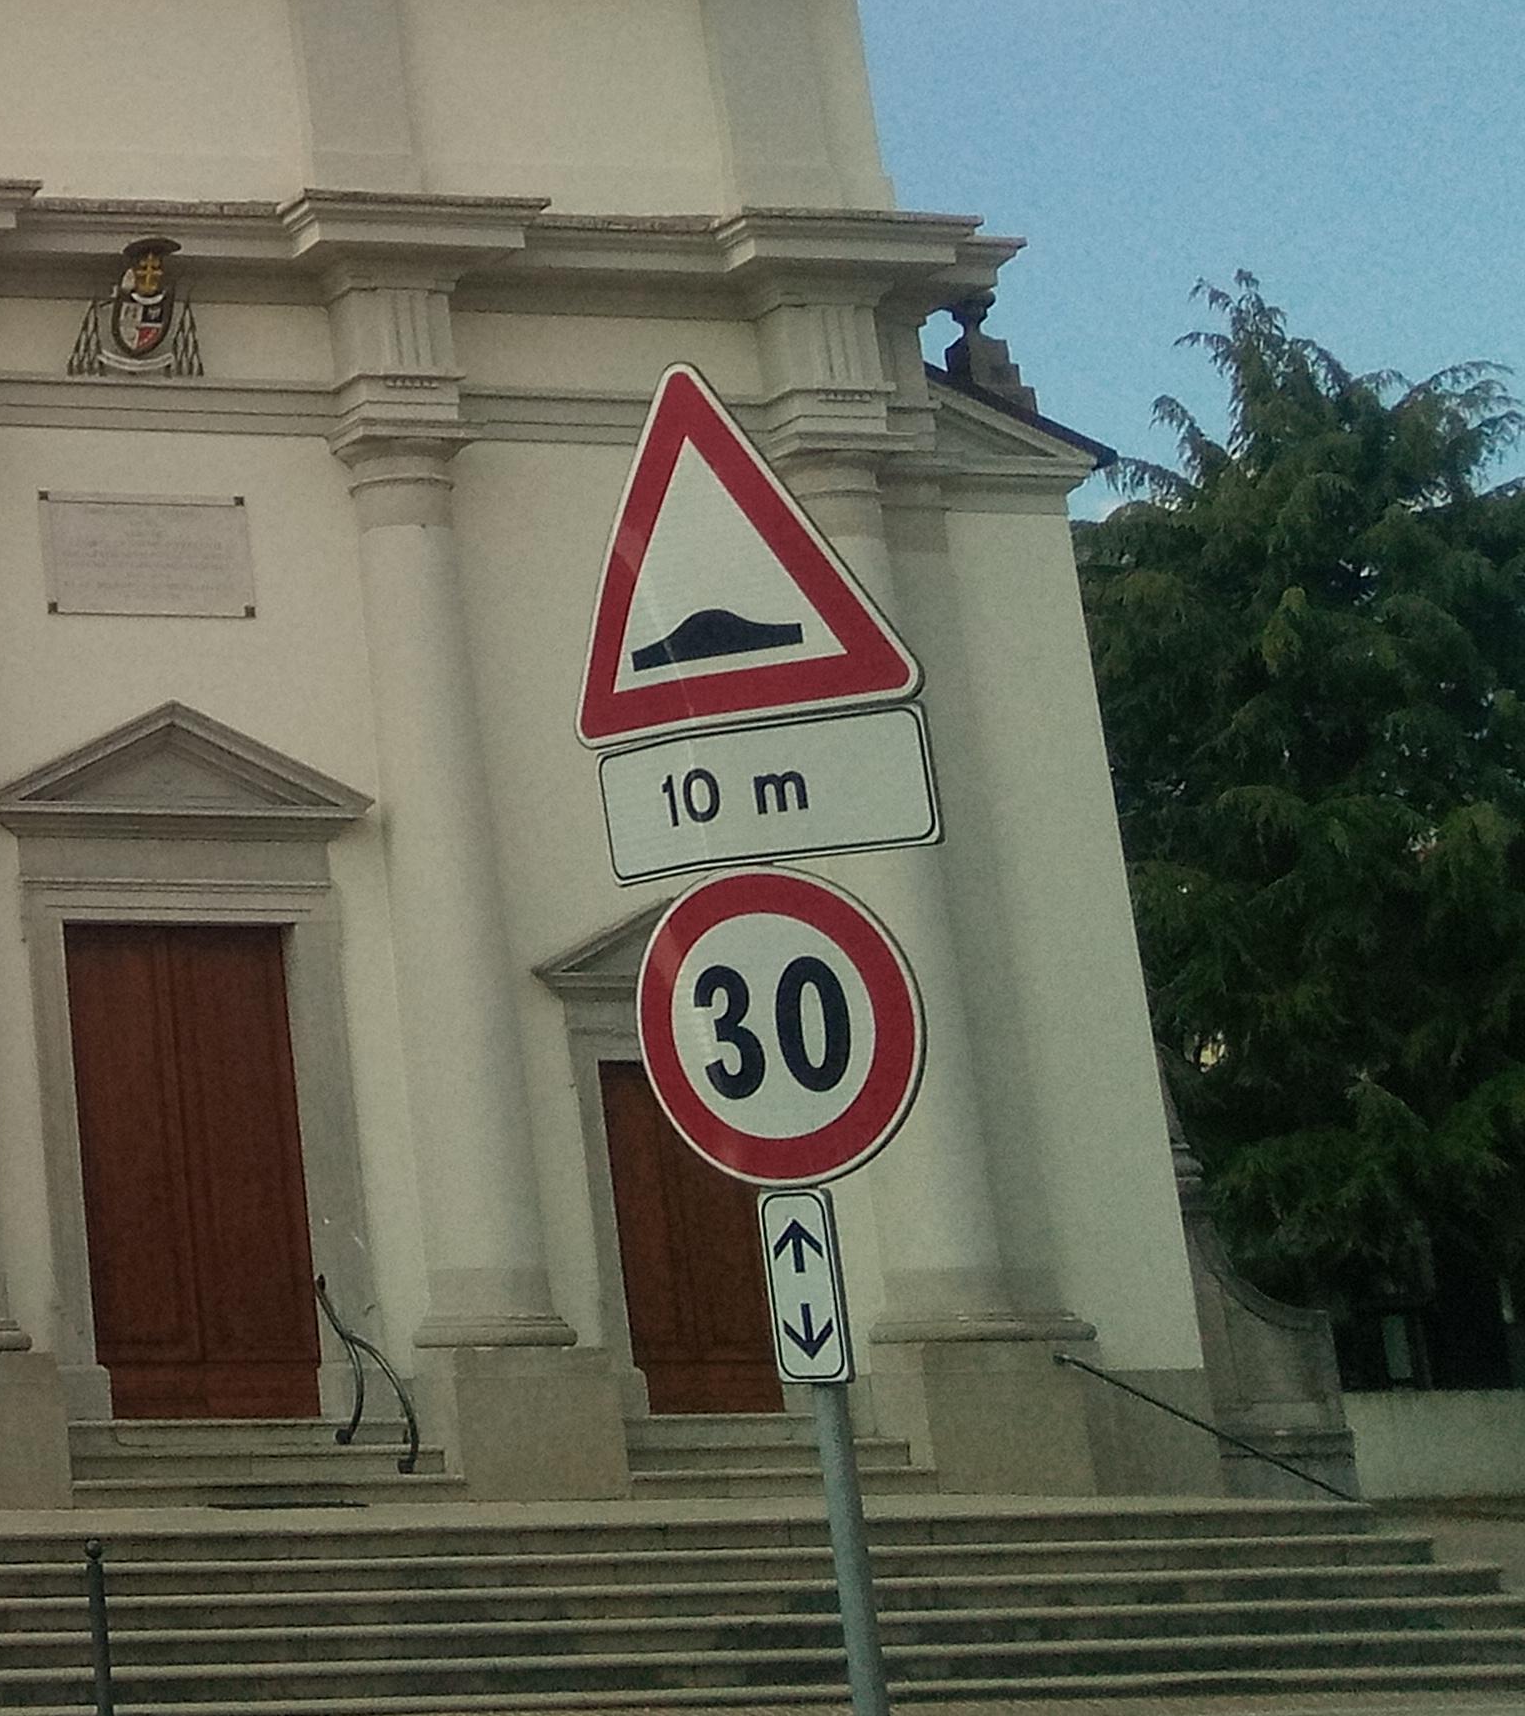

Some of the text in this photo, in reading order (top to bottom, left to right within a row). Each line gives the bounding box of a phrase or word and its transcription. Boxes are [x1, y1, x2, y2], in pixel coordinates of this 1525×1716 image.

[662, 768, 809, 827] 10 m
[694, 956, 851, 1100] 30
